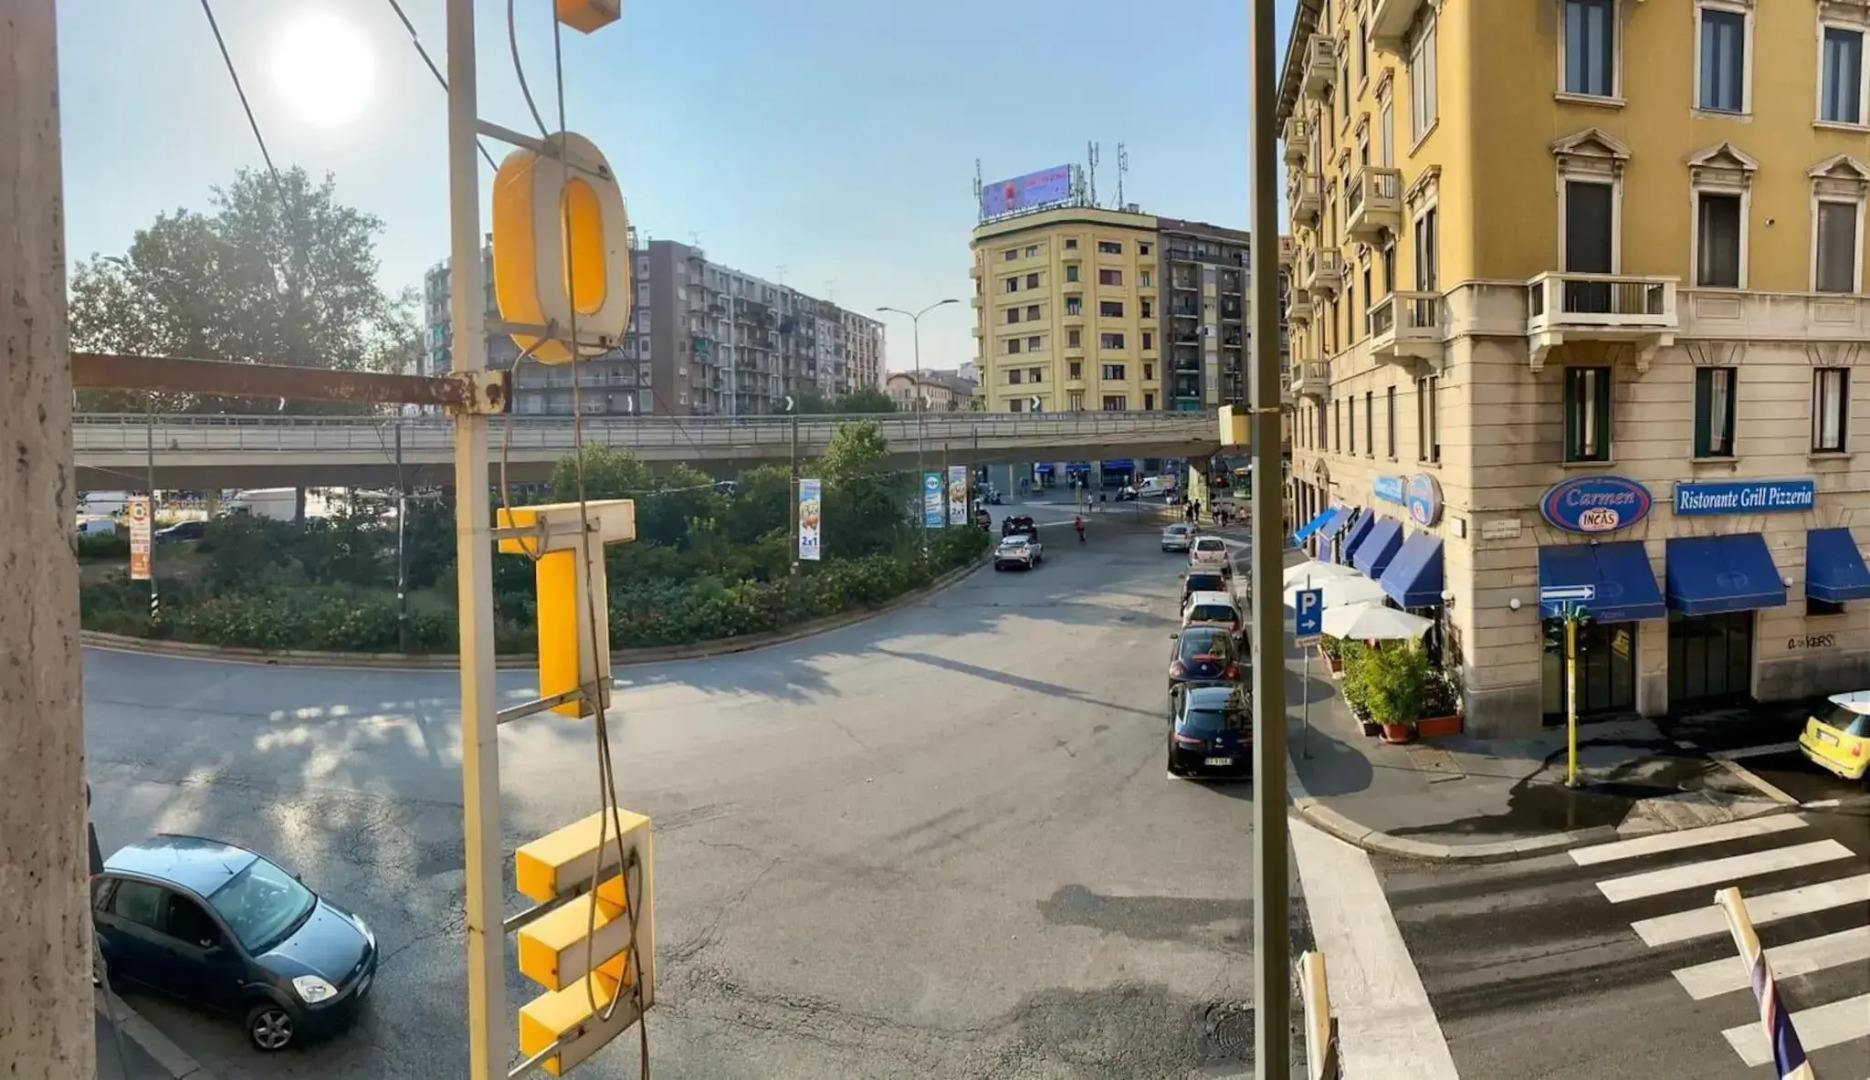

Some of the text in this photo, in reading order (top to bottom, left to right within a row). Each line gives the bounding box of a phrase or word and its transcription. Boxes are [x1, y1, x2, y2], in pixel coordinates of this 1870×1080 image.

[1565, 487, 1635, 506] Carmen
[1680, 486, 1812, 510] Ristorante Grill Pizzeria
[1583, 513, 1615, 526] INCAS
[802, 536, 817, 546] 2x1
[1302, 593, 1317, 615] P
